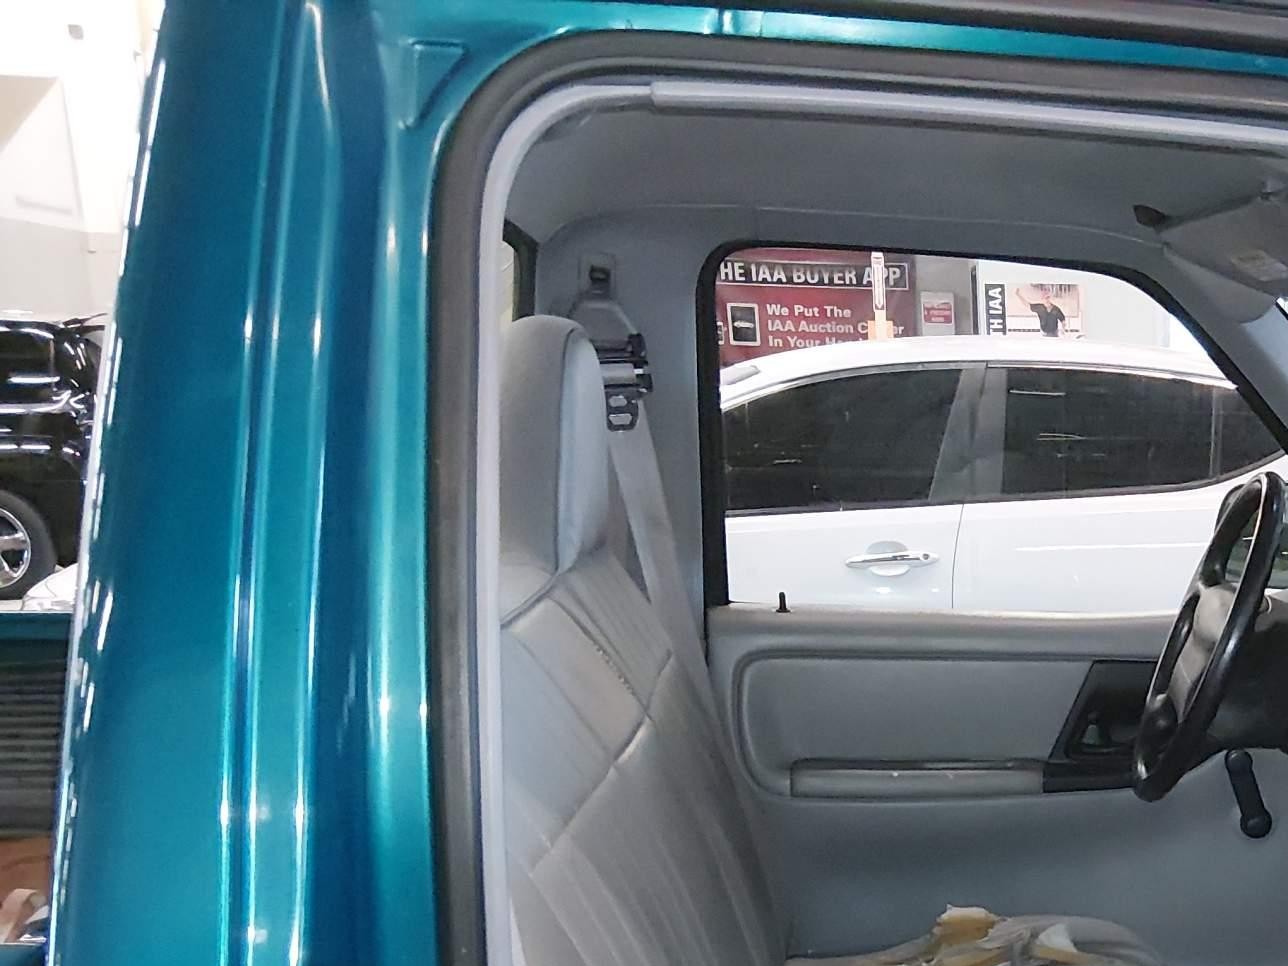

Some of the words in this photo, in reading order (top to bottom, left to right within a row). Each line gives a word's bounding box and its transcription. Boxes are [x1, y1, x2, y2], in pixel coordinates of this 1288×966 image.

[751, 263, 787, 283] IAA
[792, 265, 857, 285] BUYER
[988, 287, 1003, 315] IAA
[766, 304, 789, 316] We
[794, 304, 819, 318] Put
[824, 305, 851, 318] The
[767, 320, 795, 332] IAA
[798, 321, 854, 334] Auction
[768, 336, 783, 347] In
